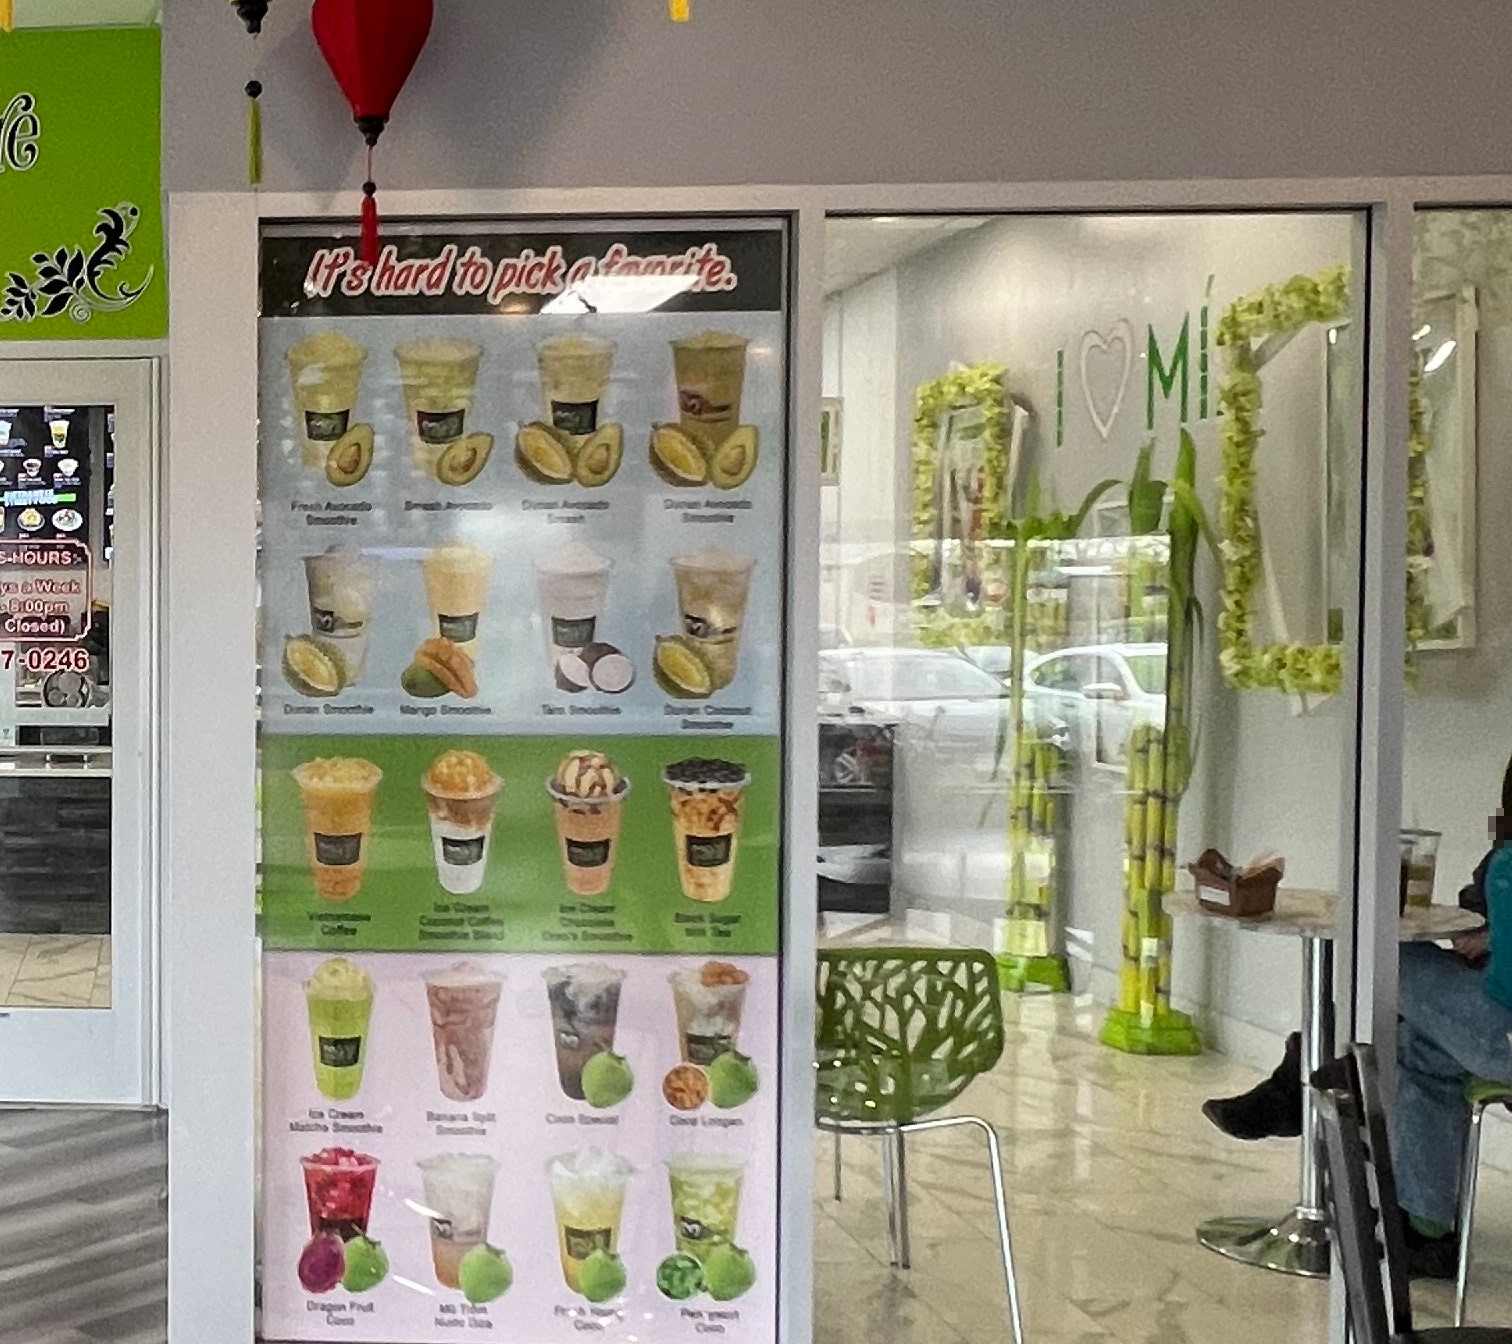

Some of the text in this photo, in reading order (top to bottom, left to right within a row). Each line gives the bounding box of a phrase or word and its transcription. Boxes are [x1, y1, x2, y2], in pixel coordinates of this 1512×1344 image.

[306, 247, 372, 297] It's
[371, 245, 457, 296] hard
[453, 246, 492, 296] to
[487, 245, 567, 305] pick
[35, 578, 82, 594] Week
[3, 617, 66, 635] Closed)
